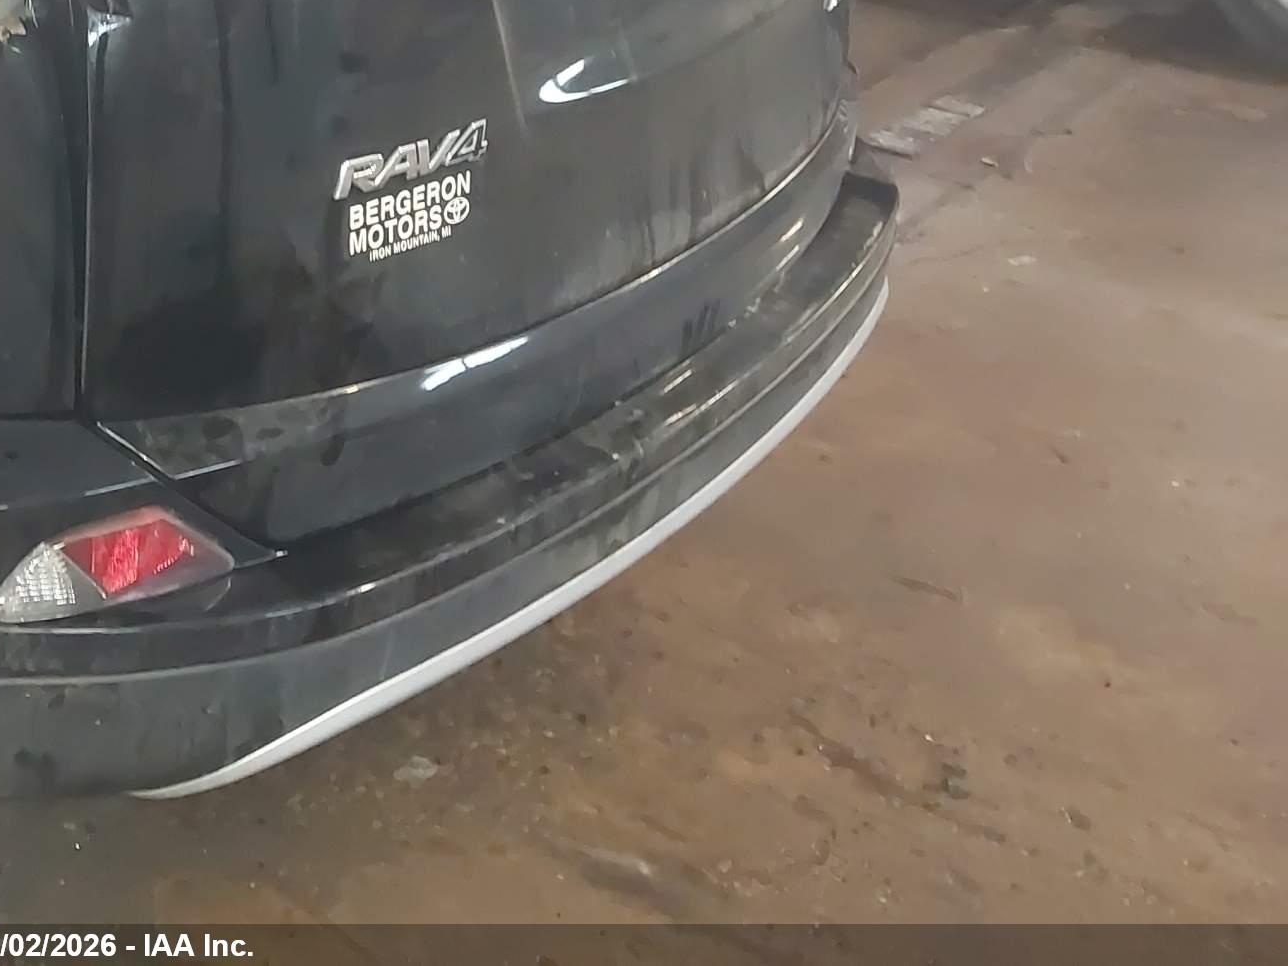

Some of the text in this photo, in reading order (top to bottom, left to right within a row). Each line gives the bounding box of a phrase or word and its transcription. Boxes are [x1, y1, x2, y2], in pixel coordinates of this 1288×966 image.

[333, 117, 488, 201] RAV4
[348, 169, 471, 231] BERGERON
[348, 204, 443, 256] MOTORS
[369, 244, 392, 263] IRON
[441, 224, 452, 239] MI
